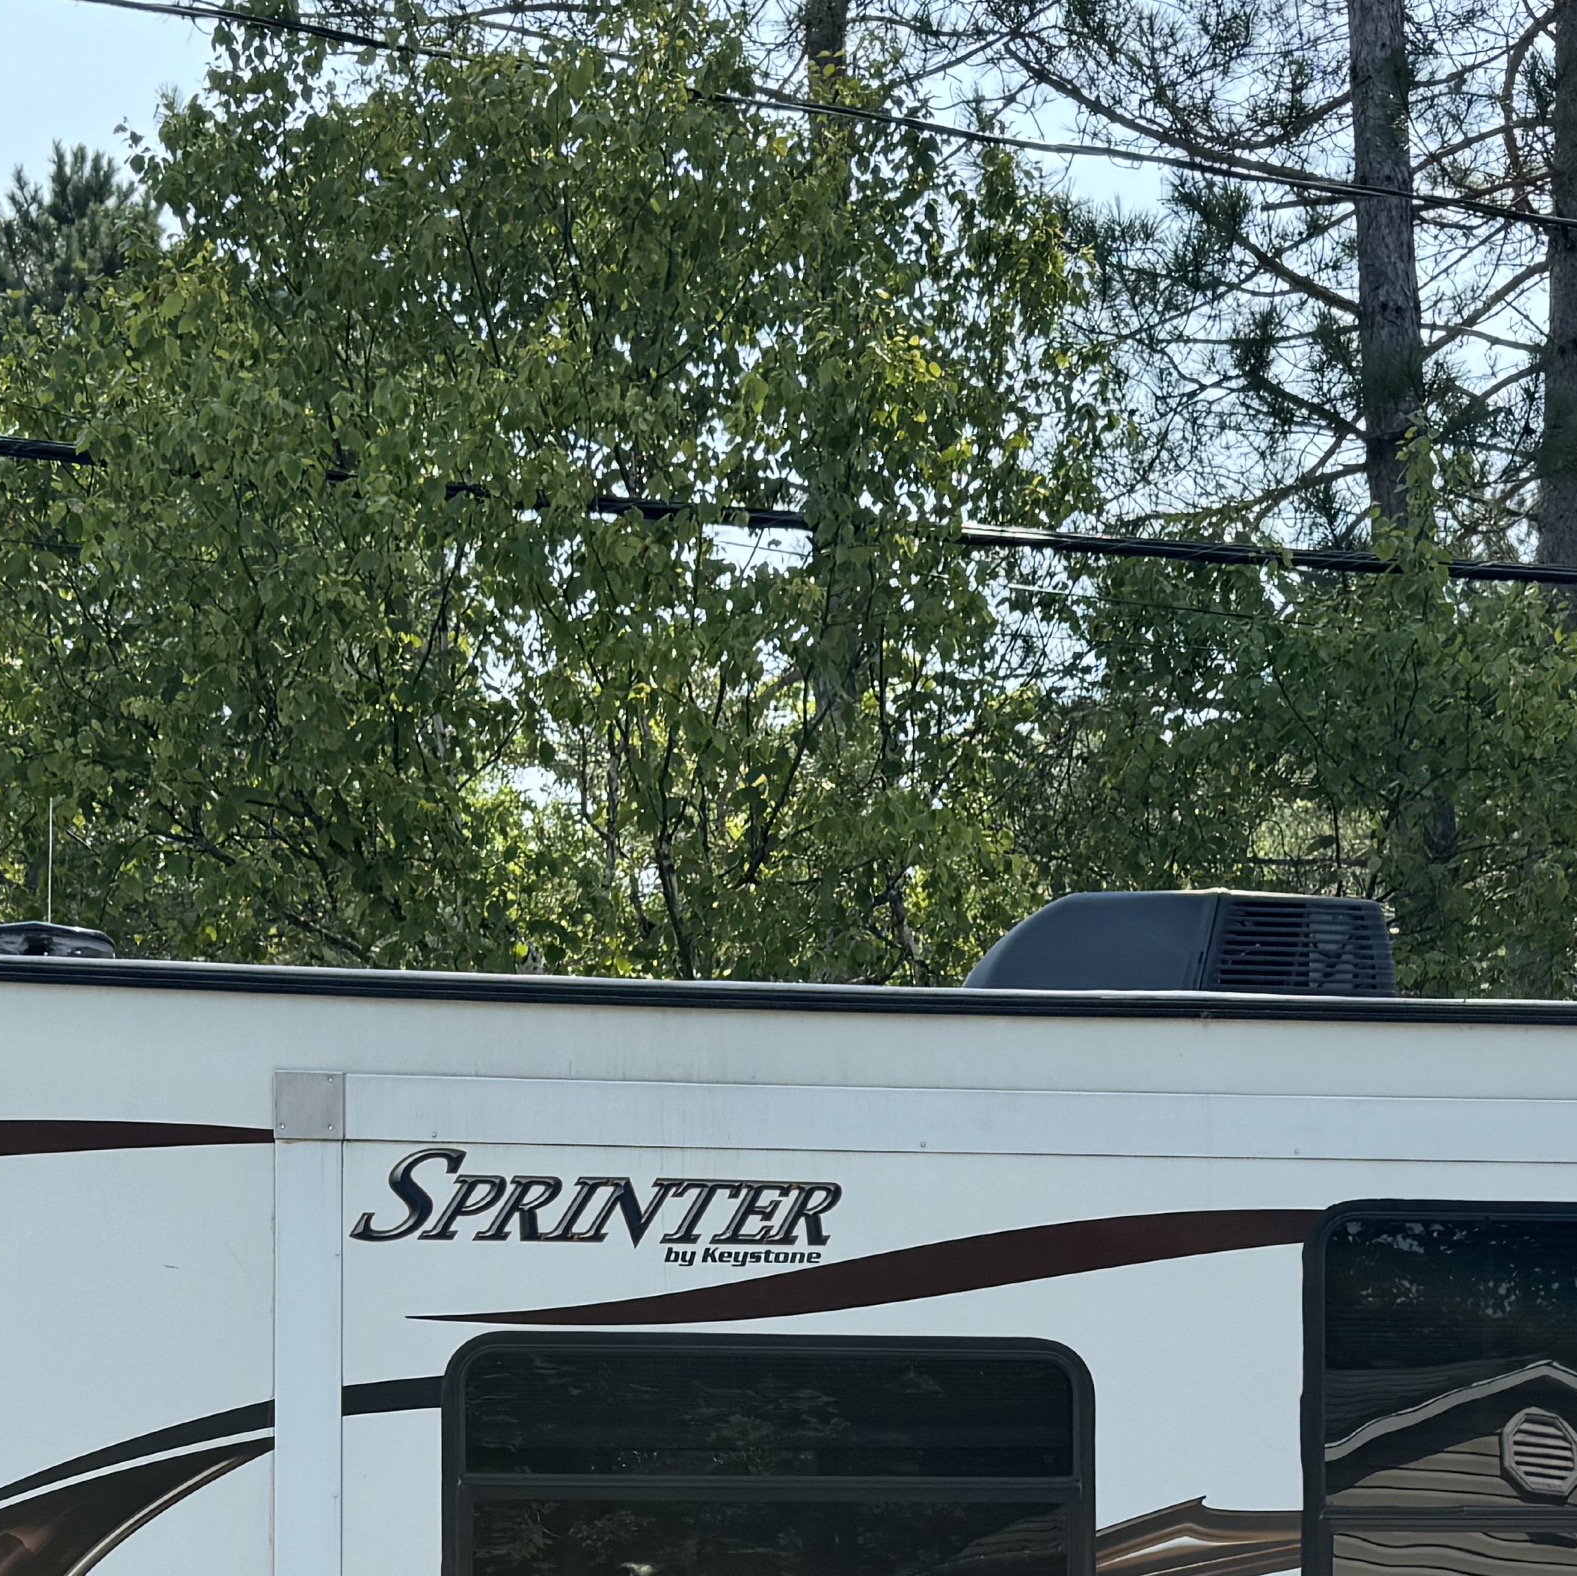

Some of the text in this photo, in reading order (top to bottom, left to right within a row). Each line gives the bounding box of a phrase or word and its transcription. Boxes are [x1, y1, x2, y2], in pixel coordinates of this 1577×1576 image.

[348, 1147, 843, 1249] SPRINTER
[664, 1246, 822, 1268] by Keystone
